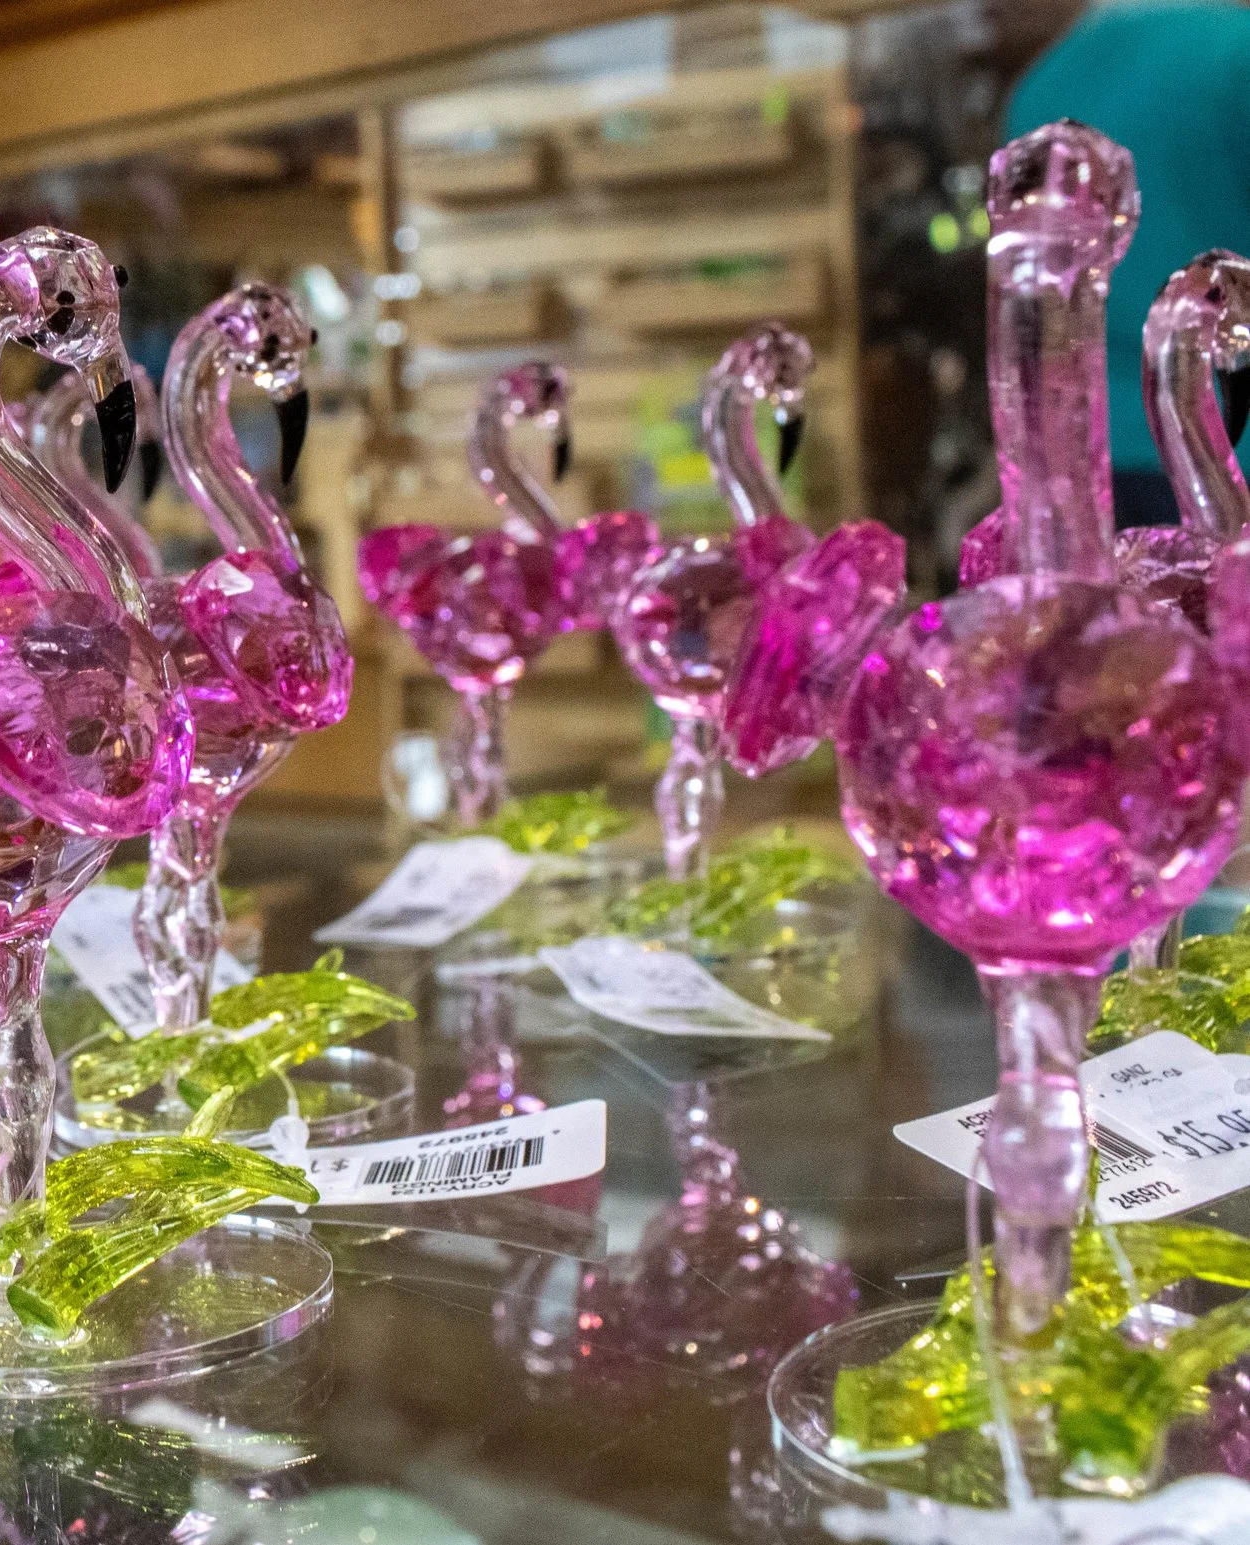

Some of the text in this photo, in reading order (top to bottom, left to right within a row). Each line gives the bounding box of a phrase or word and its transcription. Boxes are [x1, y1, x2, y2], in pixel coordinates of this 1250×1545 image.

[1111, 1064, 1151, 1083] GANZ
[418, 1126, 509, 1149] 245972
[391, 1178, 510, 1196] ACRY-1124
[392, 1171, 512, 1189] FLAMINGO
[1108, 1181, 1180, 1209] 245972
